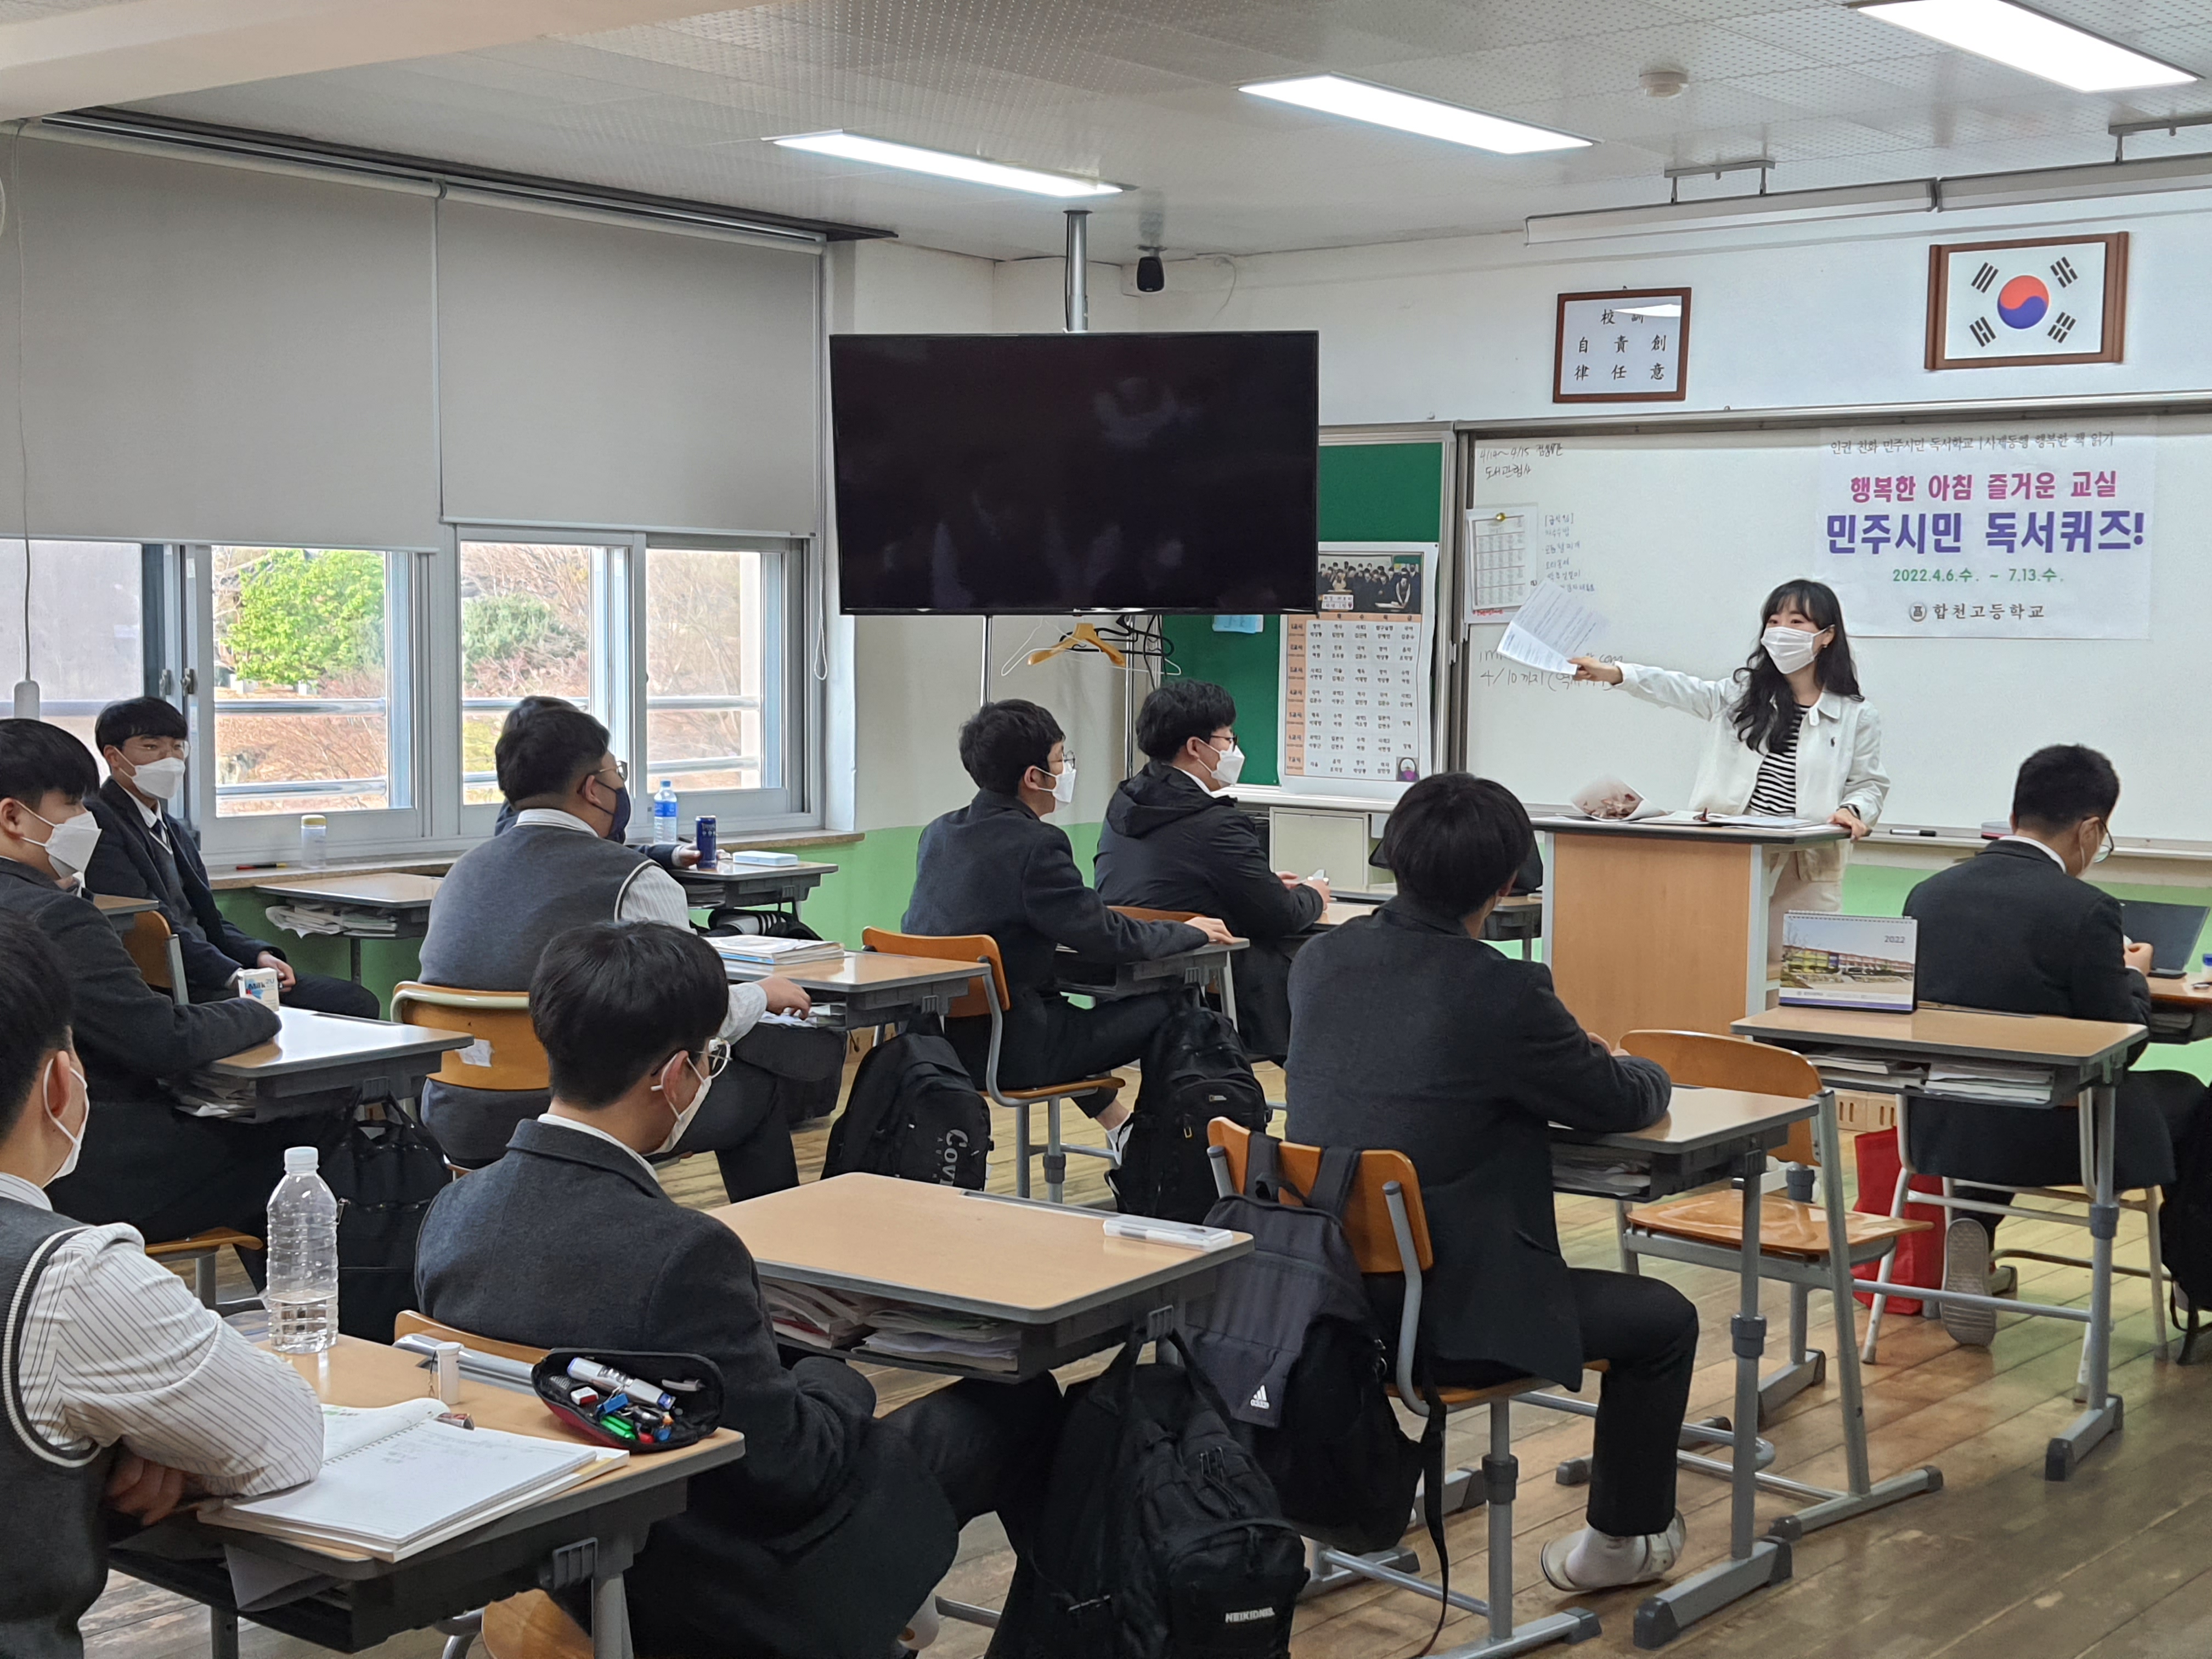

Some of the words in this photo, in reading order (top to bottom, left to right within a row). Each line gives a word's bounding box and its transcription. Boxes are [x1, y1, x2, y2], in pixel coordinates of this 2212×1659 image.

[1857, 438, 1879, 454] 친화
[1883, 437, 1925, 453] 민주시민
[1930, 436, 1973, 452] 독서학교
[1984, 434, 2029, 450] 사제동행
[2035, 432, 2069, 449] 행복한
[2075, 431, 2085, 447] 책
[2091, 431, 2114, 447] 읽기
[1850, 475, 1916, 504] 행복한
[1928, 472, 1973, 502] 아침
[1987, 471, 2056, 500] 즐거운
[2070, 470, 2118, 498] 교실
[1827, 511, 1962, 555] 민주시민
[1985, 509, 2145, 554] 독서퀴즈!
[1893, 568, 1979, 583] 2022.4.6.수.
[2008, 567, 2064, 583] 7.13.수.
[1933, 603, 2044, 620] 합천고등학교
[1884, 935, 1905, 944] 2022
